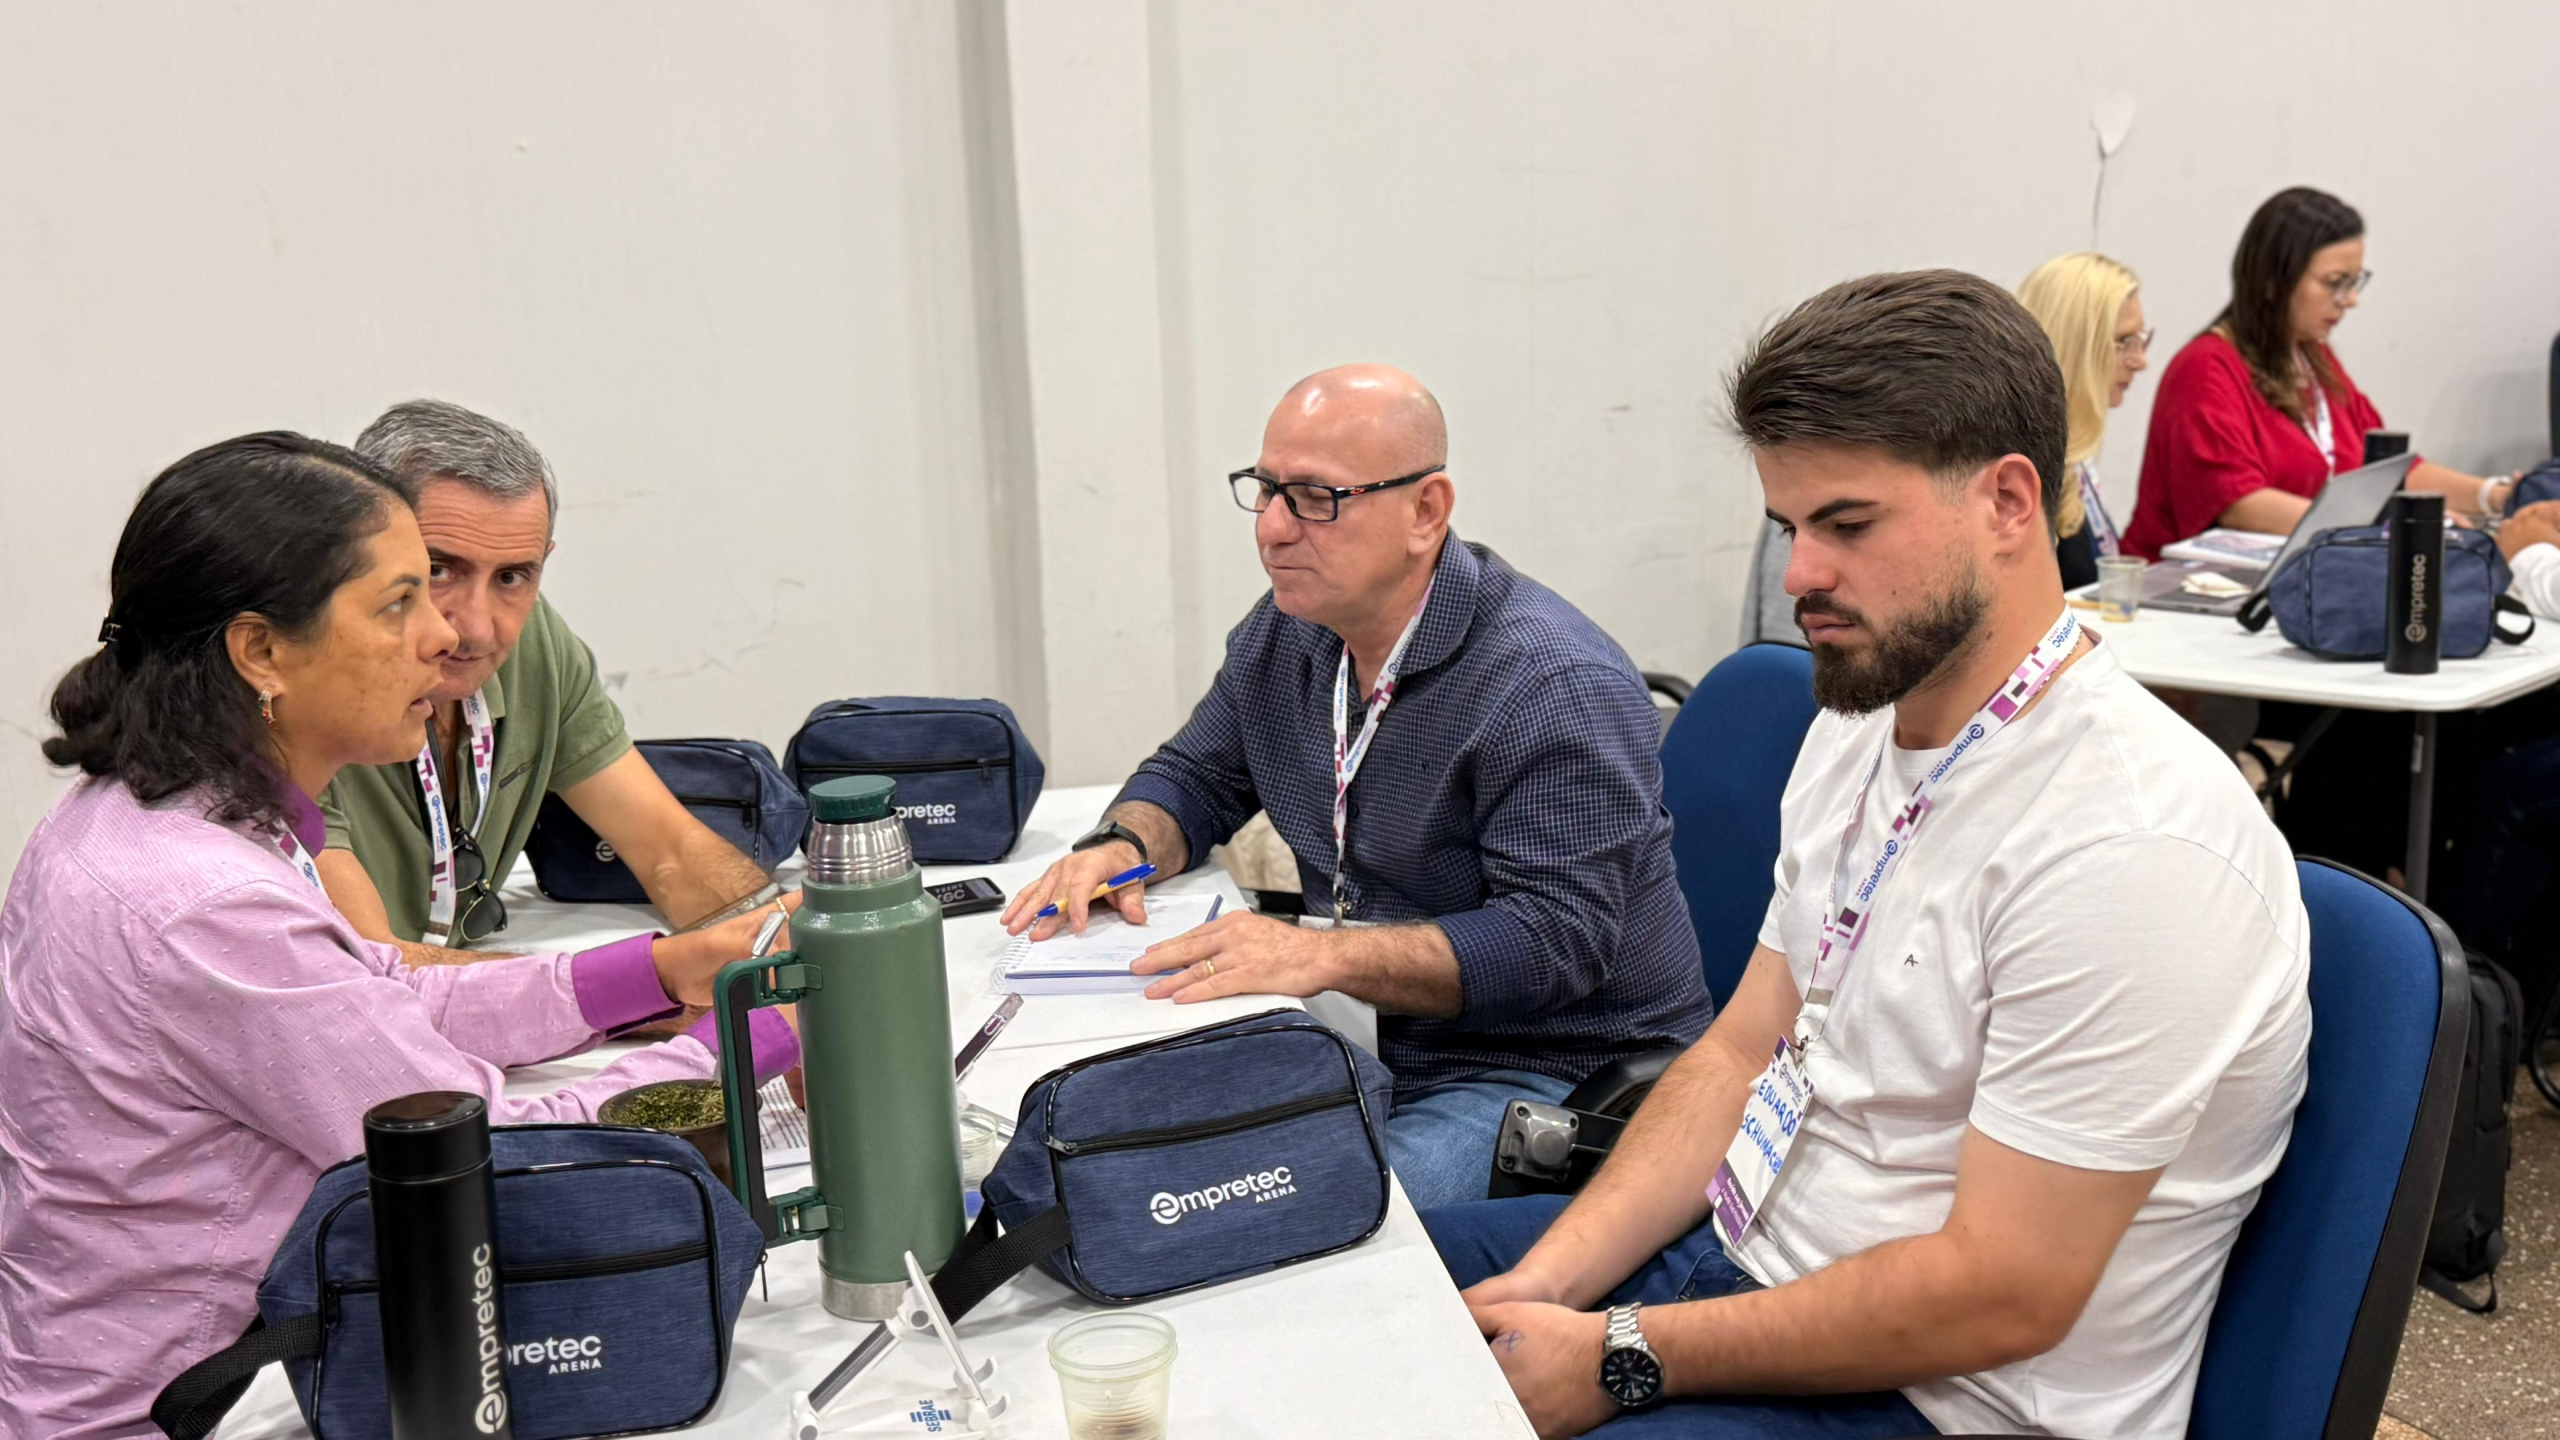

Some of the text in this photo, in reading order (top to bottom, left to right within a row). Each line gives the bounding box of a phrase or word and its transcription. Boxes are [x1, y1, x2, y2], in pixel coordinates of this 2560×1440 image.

[1931, 723, 1985, 784] empretec
[896, 803, 957, 819] pretec
[1860, 840, 1898, 902] empretec
[1150, 1166, 1292, 1225] empretec
[1255, 1184, 1298, 1203] ARENA
[472, 1242, 508, 1435] empretec
[507, 1335, 602, 1366] retec
[548, 1358, 603, 1375] ARENA
[918, 1399, 943, 1433] SEBRAE
